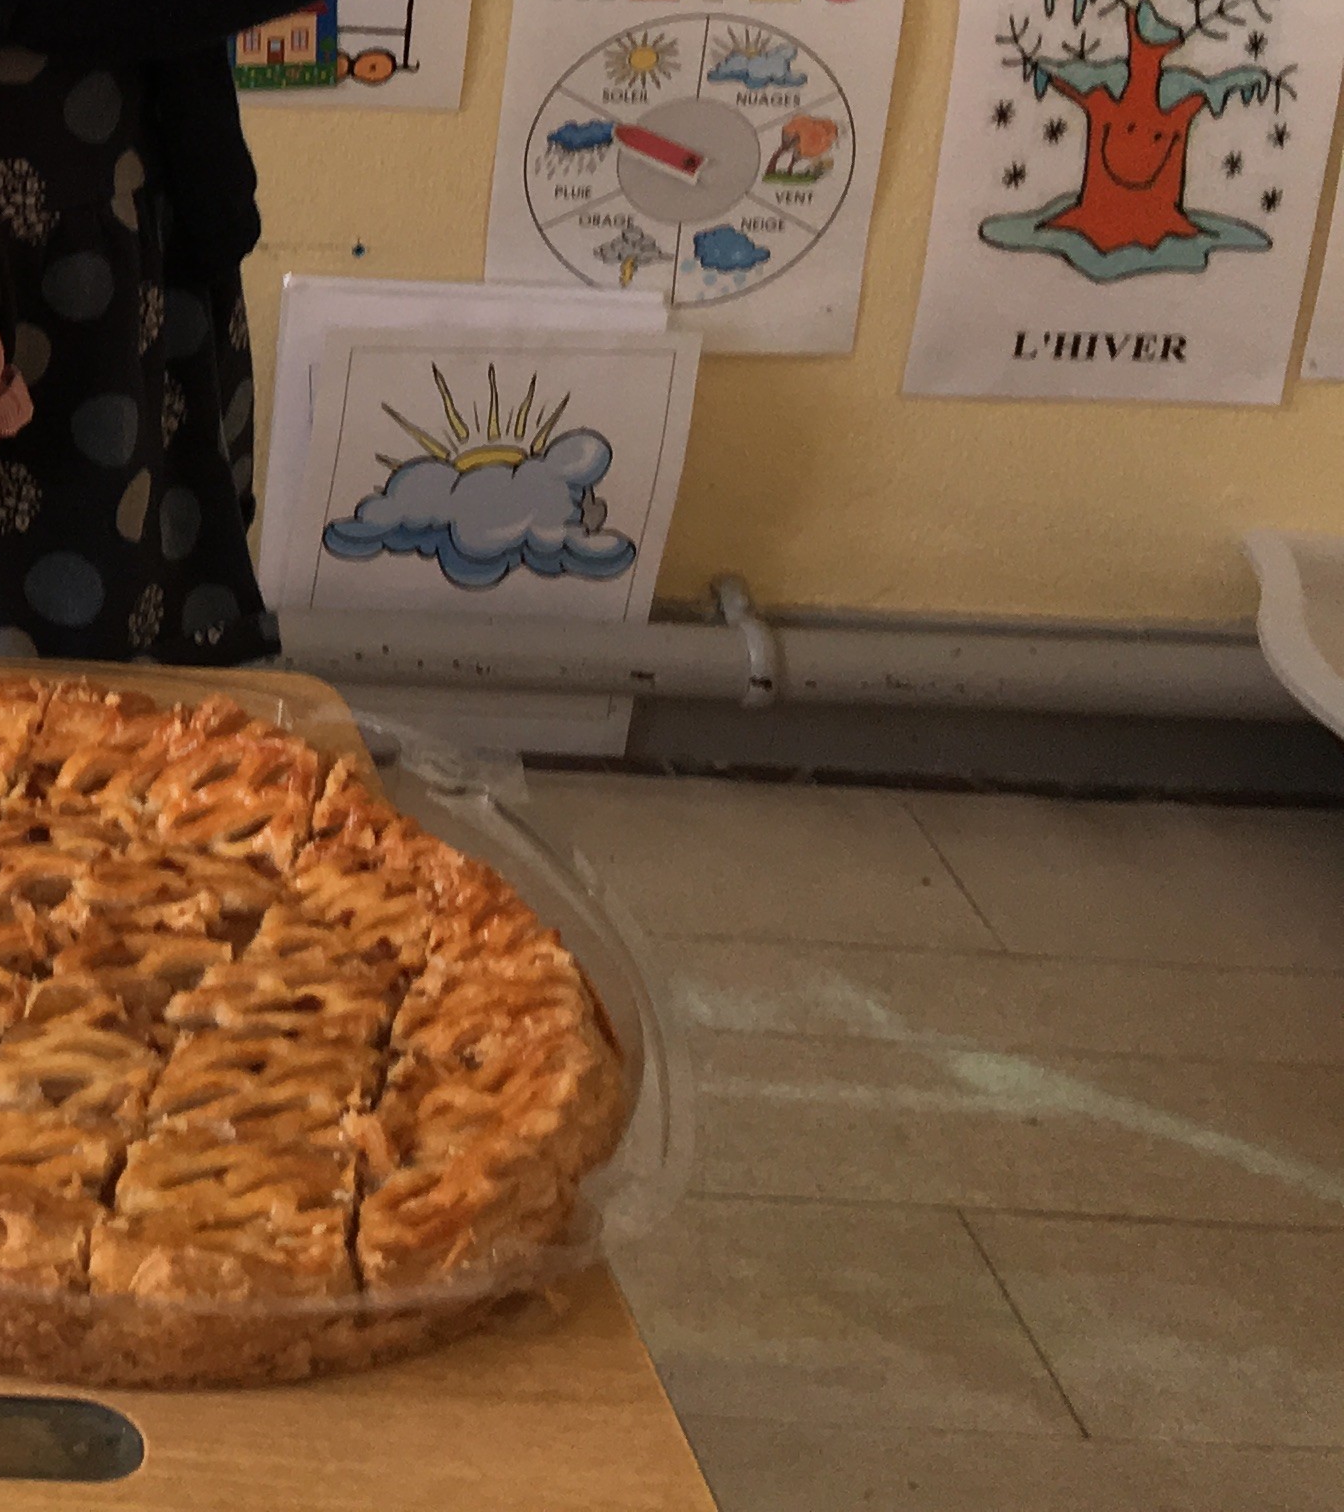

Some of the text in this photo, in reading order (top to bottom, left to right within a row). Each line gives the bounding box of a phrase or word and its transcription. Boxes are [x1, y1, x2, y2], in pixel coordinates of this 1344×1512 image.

[602, 89, 649, 105] SOLEIL
[736, 92, 801, 108] NUAGES
[554, 184, 592, 201] PLUIE
[775, 191, 815, 206] VENT
[740, 217, 786, 233] NEIGE
[1013, 331, 1188, 363] L'HIVER
